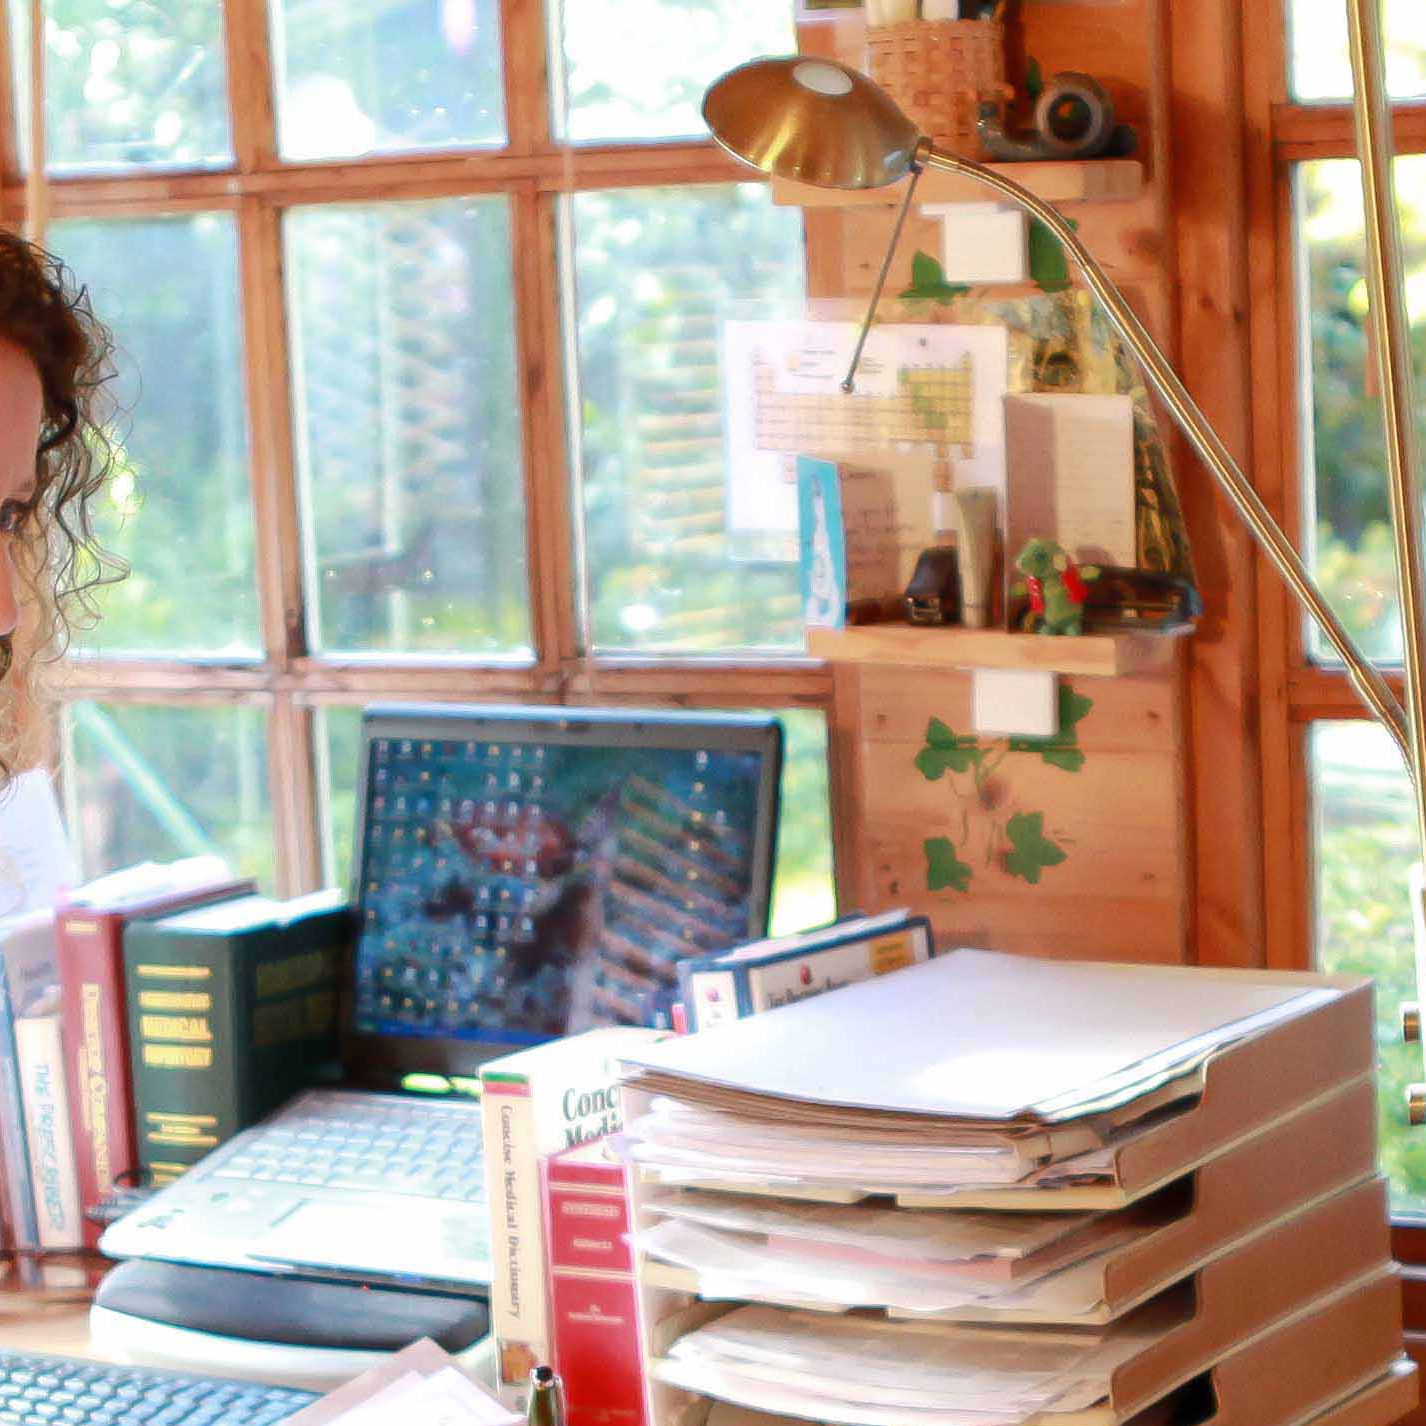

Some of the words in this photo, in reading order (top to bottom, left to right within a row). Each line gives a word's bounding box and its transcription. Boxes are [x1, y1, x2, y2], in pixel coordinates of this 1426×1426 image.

[500, 1103, 514, 1164] Concise
[504, 1167, 518, 1233] Medical
[507, 1236, 521, 1320] Dictionary
